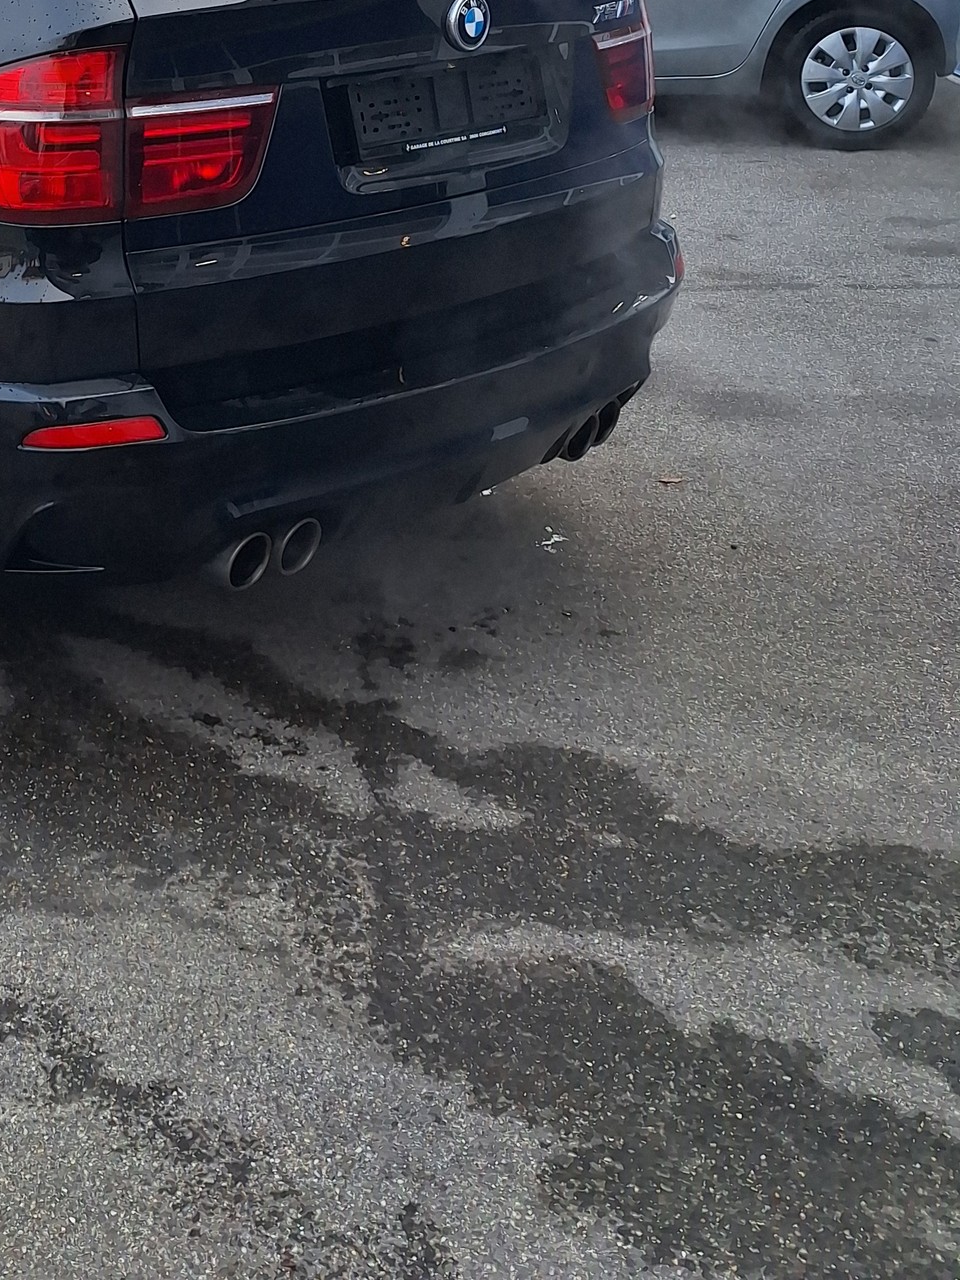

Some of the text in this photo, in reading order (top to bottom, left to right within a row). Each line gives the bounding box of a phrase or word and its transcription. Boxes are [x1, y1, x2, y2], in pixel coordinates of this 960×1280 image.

[460, 0, 486, 16] BMW
[410, 142, 428, 150] GARAGE
[440, 136, 461, 145] COURTINE
